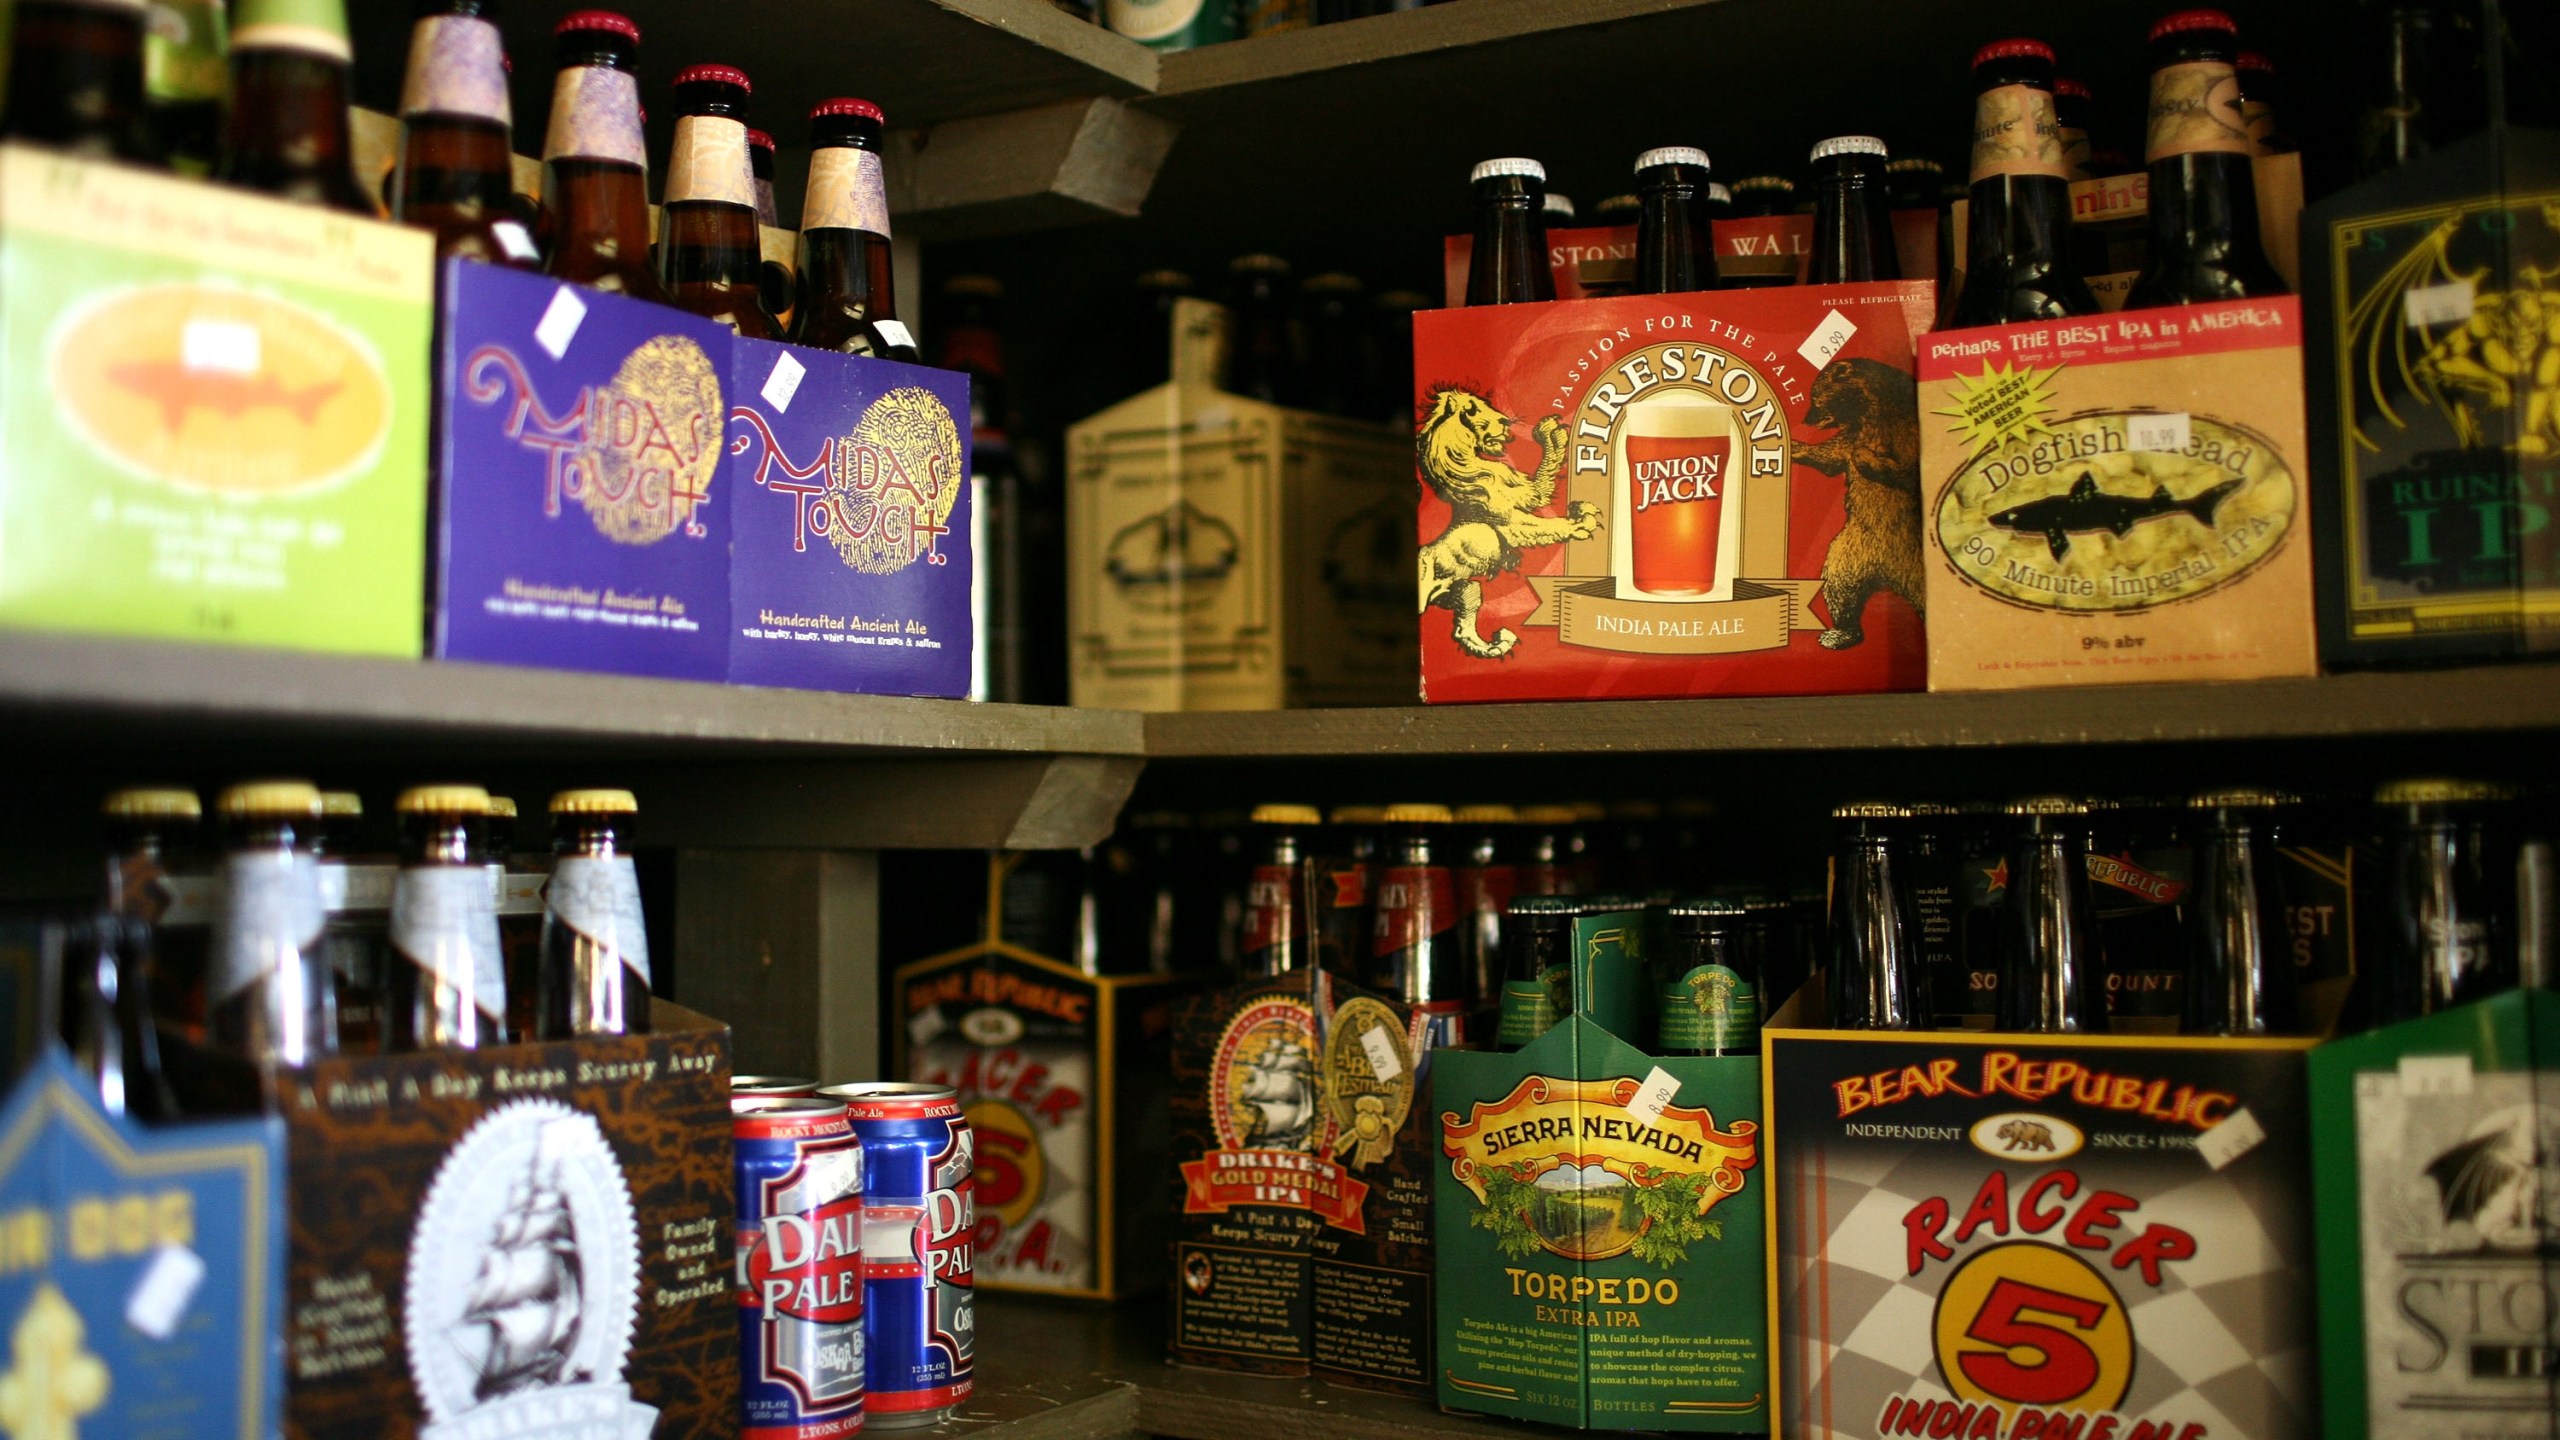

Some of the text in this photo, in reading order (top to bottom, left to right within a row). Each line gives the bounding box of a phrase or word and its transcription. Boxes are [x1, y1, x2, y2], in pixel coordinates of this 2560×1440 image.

[1552, 243, 1637, 266] STON
[1823, 294, 1921, 306] PLEASE REFRIGERATE
[1820, 330, 1846, 357] 9.99
[1932, 309, 2283, 359] perhaps THE BEST IPA in AMERICA
[1553, 315, 1804, 409] PASSION FOR THE PALE
[464, 344, 704, 468] MIDAS
[1965, 377, 2025, 416] Voted BEST
[1974, 388, 2030, 426] AMERICAN
[1575, 347, 1785, 477] FIRESTONE
[1994, 406, 2023, 428] BEER
[731, 405, 942, 506] MIDAS
[1635, 454, 1720, 481] UNION
[1980, 427, 2252, 493] Dogfish ead
[519, 432, 708, 538] TOUCH
[1636, 473, 1718, 511] JACK
[768, 480, 950, 566] TOUCH
[1963, 514, 2271, 598] 90 Minute Imperial IPA
[759, 608, 928, 636] Handcrafted Ancient Ale
[1596, 613, 1745, 637] INDIA PALE ALE
[742, 627, 763, 638] with
[905, 637, 913, 648] &
[915, 638, 941, 649] saffron
[2081, 635, 2146, 650] 9% abv
[2085, 856, 2169, 899] REPUBLIC
[1686, 972, 1736, 988] TORPEDO
[1369, 1044, 1387, 1070] 9.99
[493, 1066, 568, 1091] Keeps
[577, 1060, 657, 1083] Scurvy
[667, 1054, 716, 1074] Away
[1648, 1086, 1674, 1115] 8.99
[1833, 1050, 2238, 1129] BEAR REPUBLIC
[847, 1107, 866, 1117] Pale
[868, 1108, 884, 1118] Ale
[770, 1124, 810, 1138] ROCKY
[1483, 1114, 1704, 1164] SIERRA NEVADA
[1844, 1122, 1962, 1142] INDEPENDENT
[1218, 1153, 1337, 1181] DRAKE'S
[1210, 1170, 1341, 1200] GOLD MEDAL
[1254, 1185, 1303, 1204] IPA
[1393, 1176, 1421, 1190] Hand
[663, 1217, 717, 1241] Family
[1211, 1223, 1301, 1247] Keeps Scurvy
[1391, 1217, 1425, 1232] Small
[1902, 1169, 2197, 1288] RACER
[665, 1236, 715, 1262] Owned
[677, 1259, 706, 1281] and
[655, 1276, 724, 1307] Operated
[763, 1269, 855, 1322] PALE
[1504, 1266, 1680, 1306] TORPEDO
[1535, 1304, 1641, 1328] EXTRA IPA
[1456, 1330, 1489, 1344] Utilizing
[1490, 1334, 1503, 1345] the
[1563, 1347, 1578, 1355] our
[1590, 1348, 1624, 1359] unique
[1626, 1347, 1664, 1358] method
[1666, 1348, 1676, 1358] of
[1743, 1352, 1757, 1360] we
[1463, 1317, 1752, 1346] Torpedo Ale is big American IPA full of hop flavor and aromas.
[1957, 1275, 2109, 1406] 5
[912, 1365, 921, 1374] 12
[1458, 1344, 1487, 1356] harness
[1488, 1348, 1521, 1360] precious
[1521, 1353, 1536, 1362] oils
[1537, 1356, 1552, 1365] and
[1554, 1358, 1578, 1369] resins
[1590, 1362, 1600, 1370] to
[1602, 1362, 1649, 1371] showcase
[1650, 1362, 1667, 1372] the
[1669, 1364, 1710, 1374] complex
[1478, 1361, 1740, 1387] pine and herbal flavor and aromas that hops have to offer.
[1593, 1398, 1656, 1412] BOTTLES
[1879, 1396, 2119, 1440] INDIA PALE
